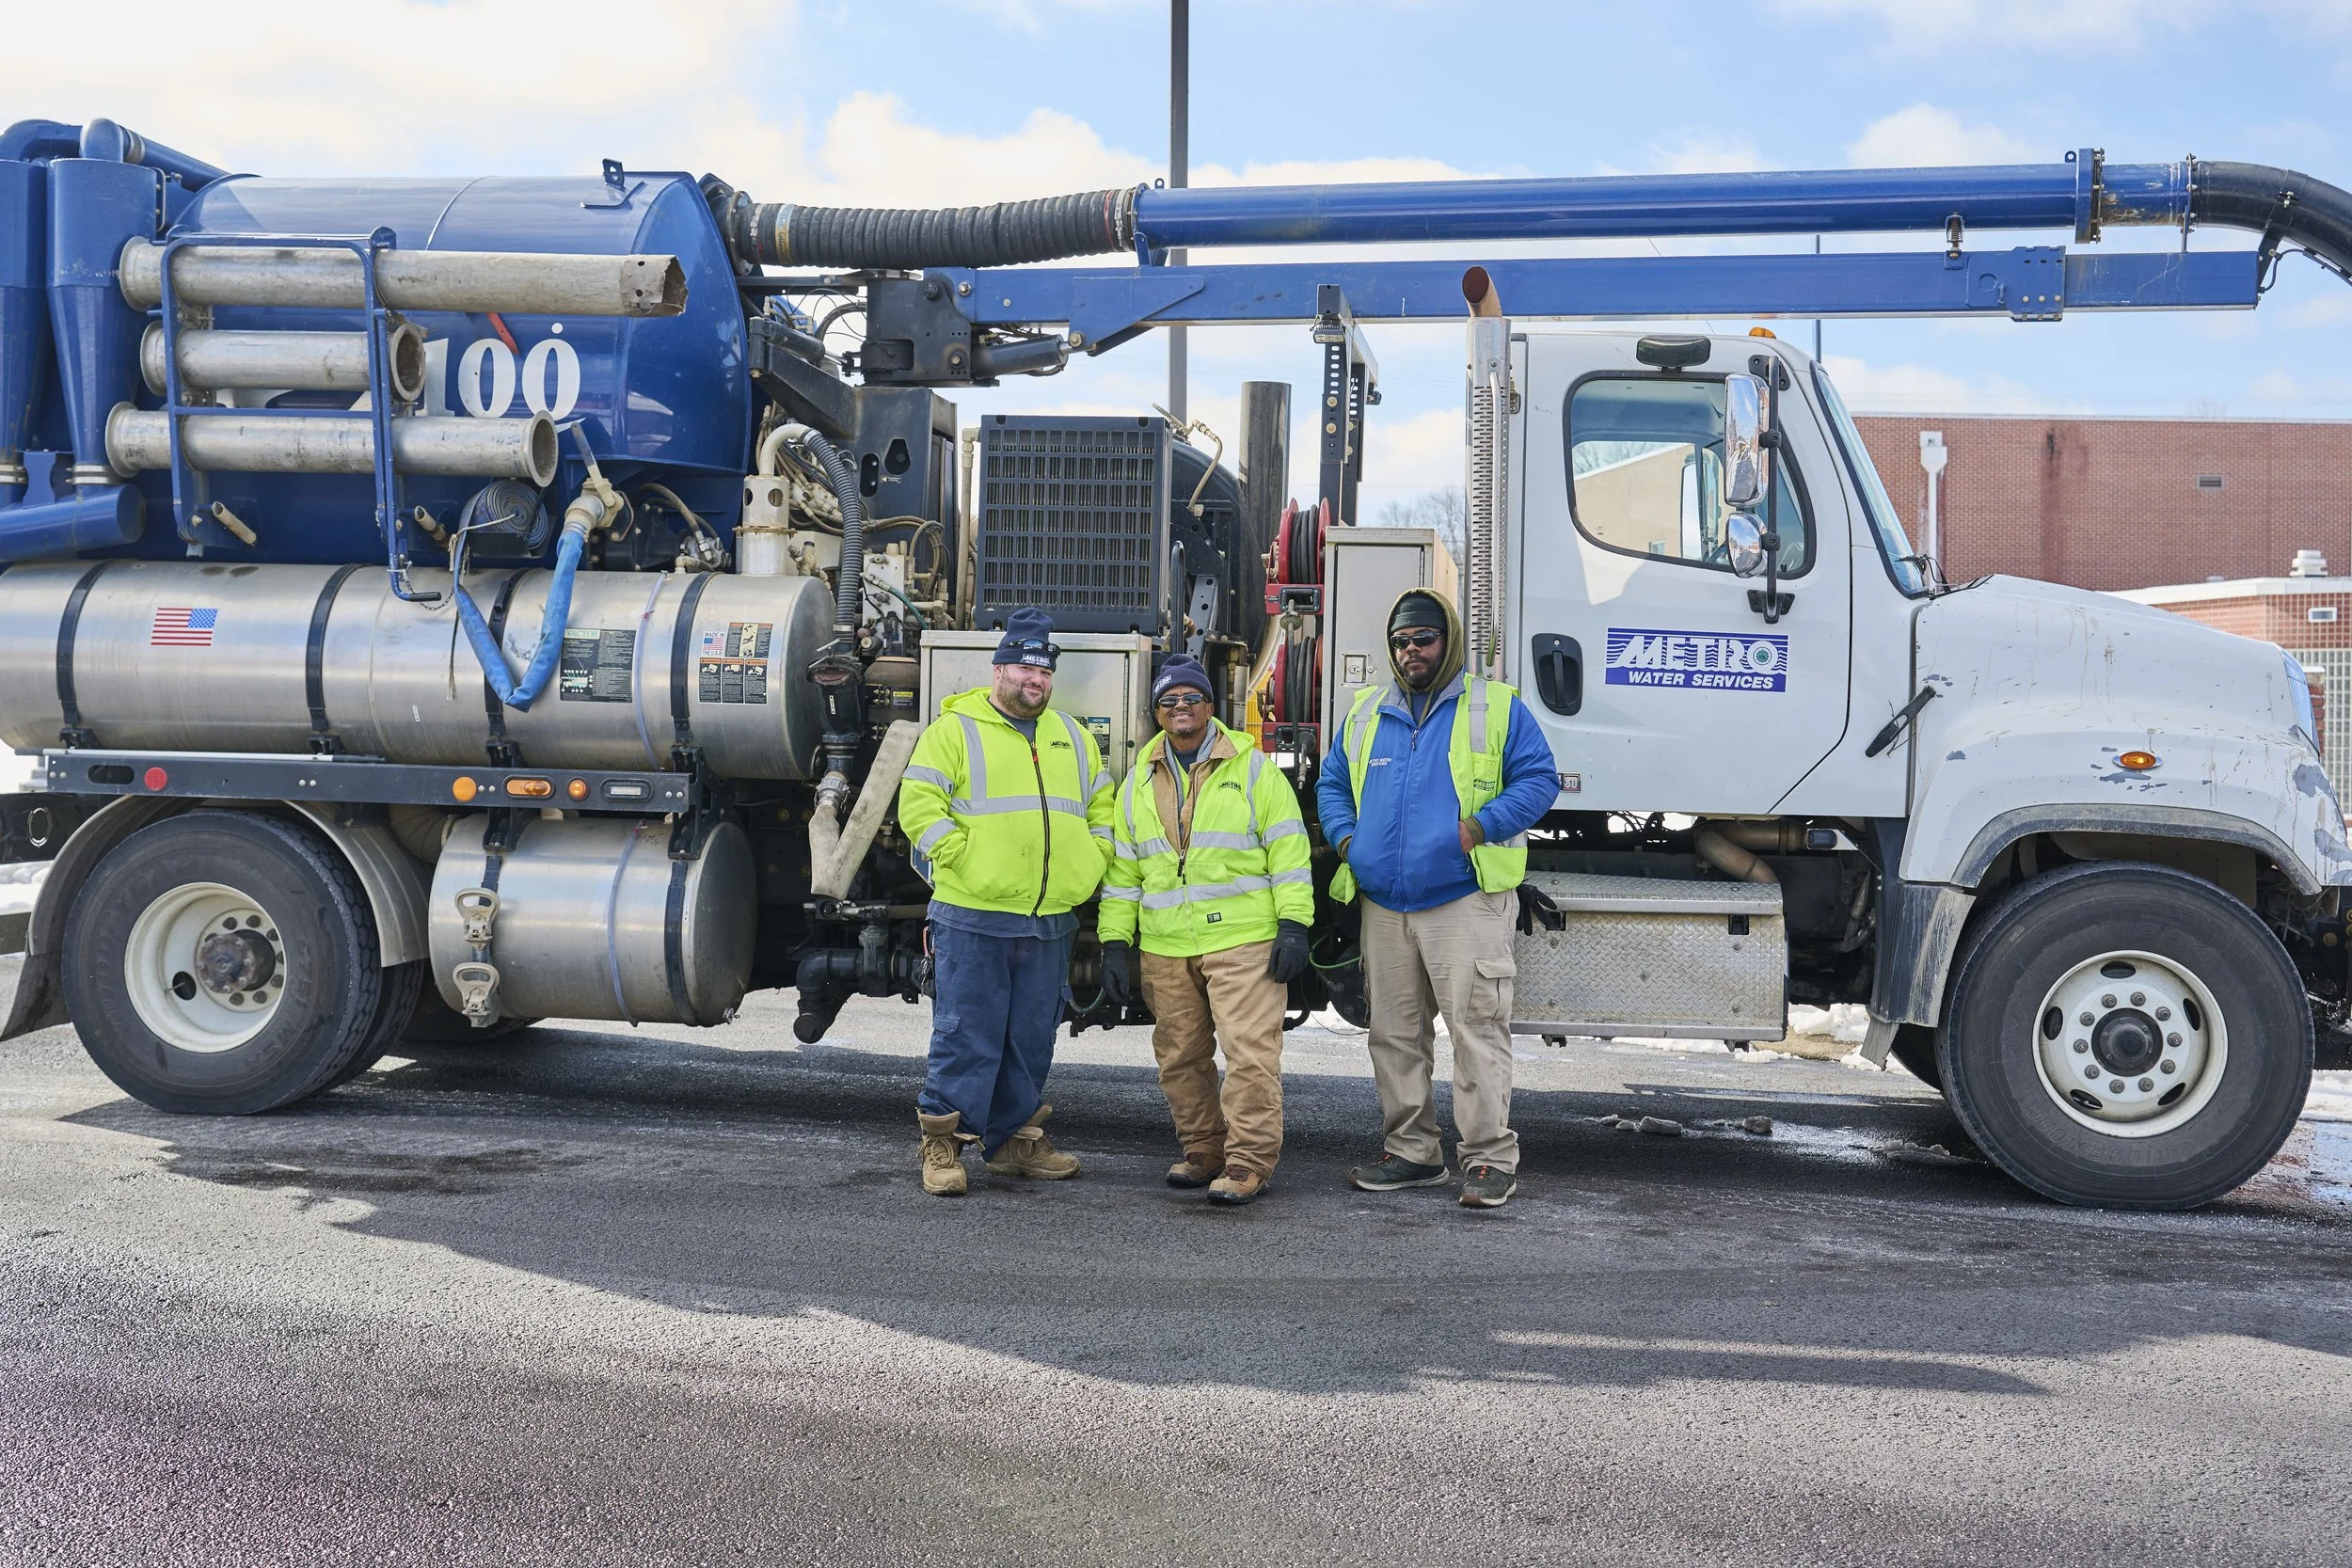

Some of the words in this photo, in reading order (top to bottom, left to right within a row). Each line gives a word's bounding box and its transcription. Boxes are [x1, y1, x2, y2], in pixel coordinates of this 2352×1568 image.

[566, 629, 598, 639] VACTOR
[1610, 635, 1779, 675] METRO
[1629, 671, 1685, 686] WATER
[1692, 673, 1774, 689] SERVICES
